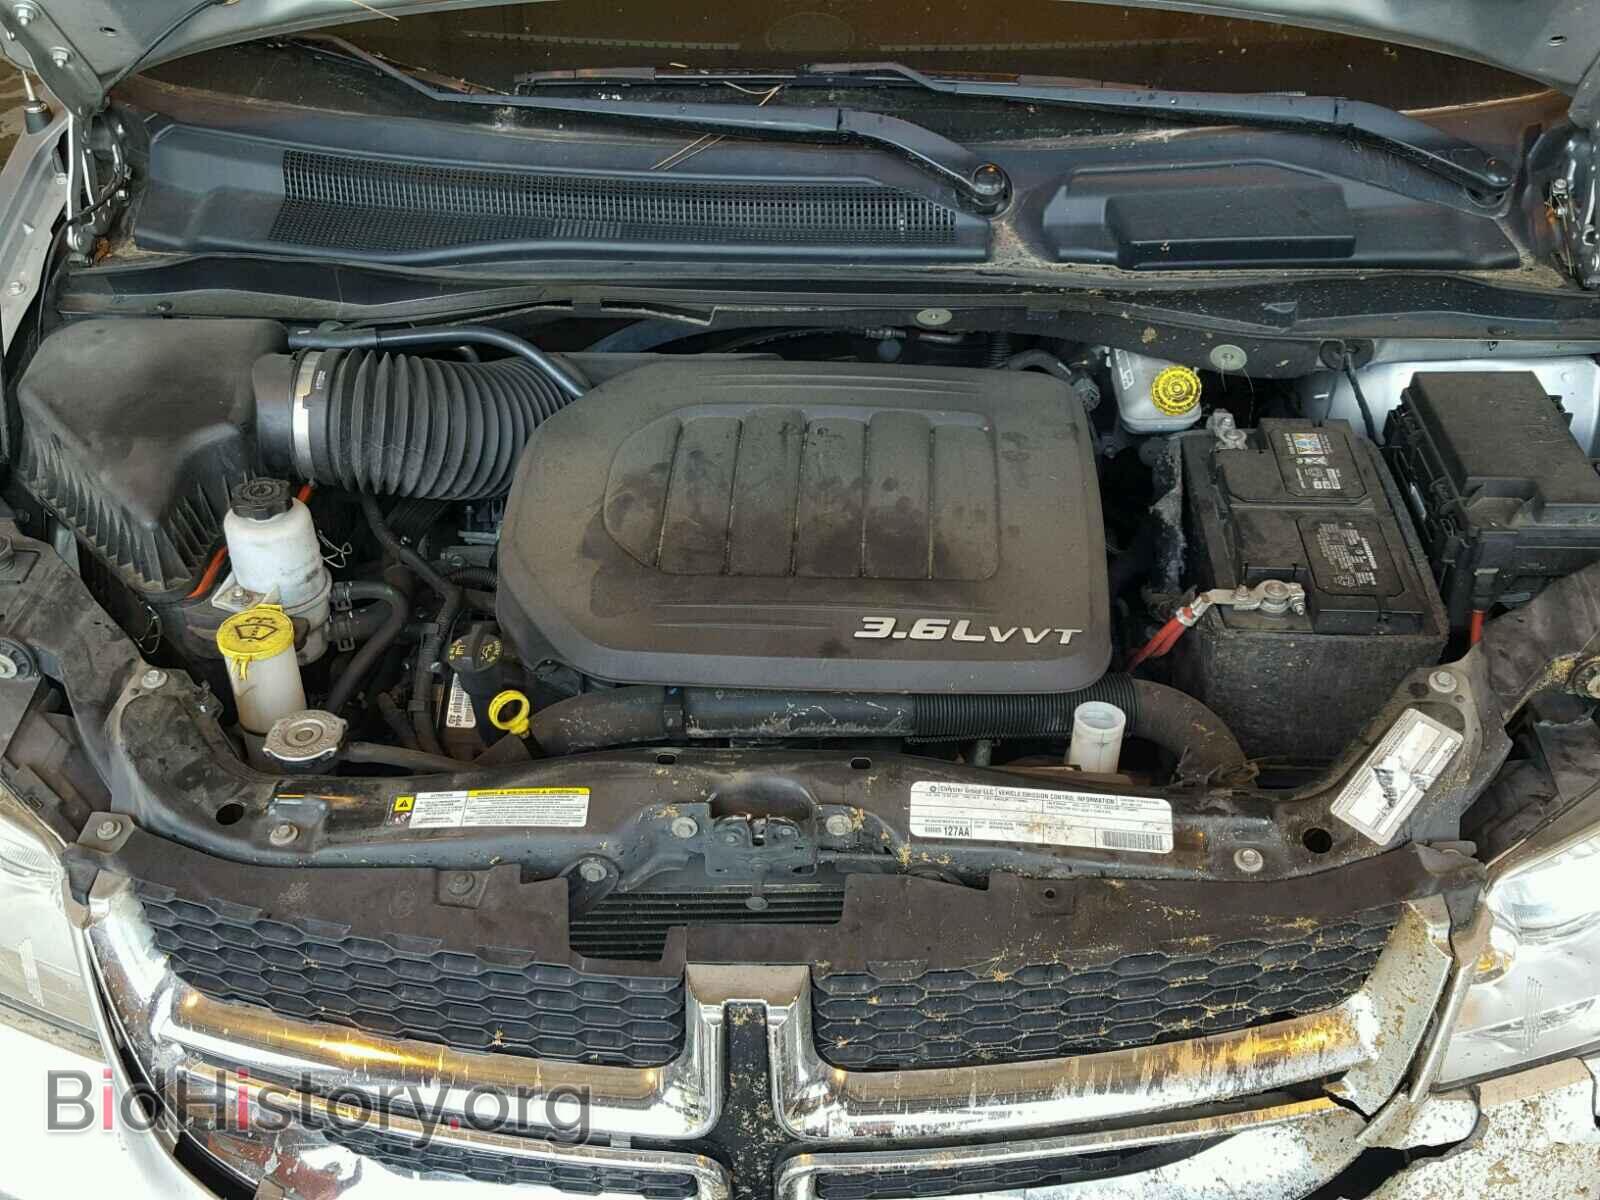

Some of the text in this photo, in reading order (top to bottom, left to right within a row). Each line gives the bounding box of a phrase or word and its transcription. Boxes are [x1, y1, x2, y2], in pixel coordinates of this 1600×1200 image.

[853, 616, 1083, 645] 3.6L VVT
[1050, 793, 1074, 801] CONTROL
[1077, 795, 1115, 804] INFORMATION
[944, 826, 970, 837] 127AA
